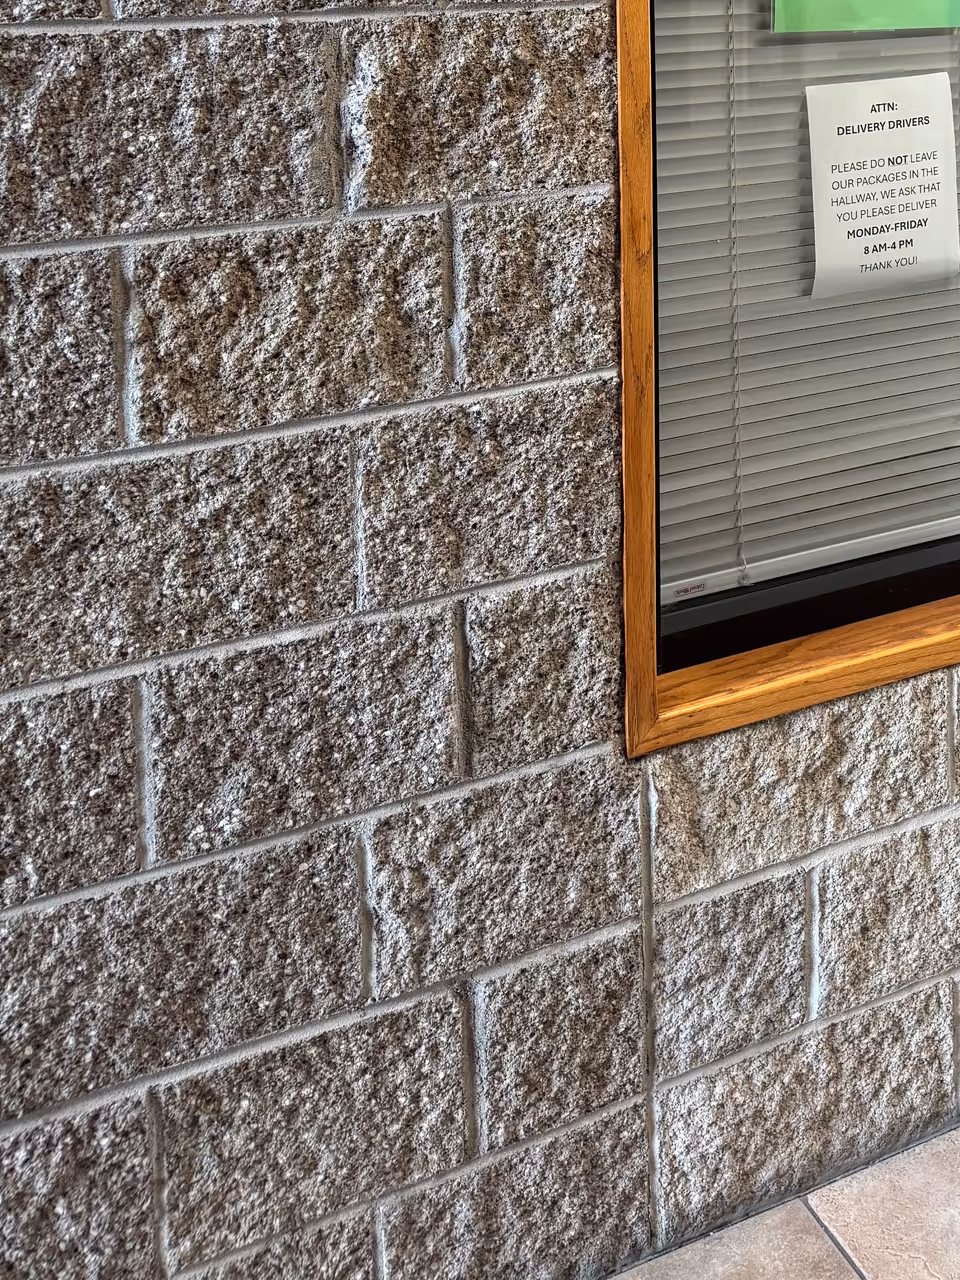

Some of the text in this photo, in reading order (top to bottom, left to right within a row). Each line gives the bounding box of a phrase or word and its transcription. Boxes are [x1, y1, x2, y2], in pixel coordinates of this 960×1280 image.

[870, 102, 898, 114] ATTN:
[837, 115, 930, 136] DELIVERY DRIVERS
[831, 150, 938, 174] PLEASE DO NOT LEAVE
[831, 166, 939, 191] OUR PACKAGES IN THE
[830, 182, 942, 207] HALLWAY, WE ASK THAT
[836, 198, 938, 223] YOU PLEASE DELIVER
[847, 218, 929, 239] MONDAY-FRIDAY
[863, 238, 914, 255] 8 AM-4 PM
[859, 256, 918, 273] THANK YOU!
